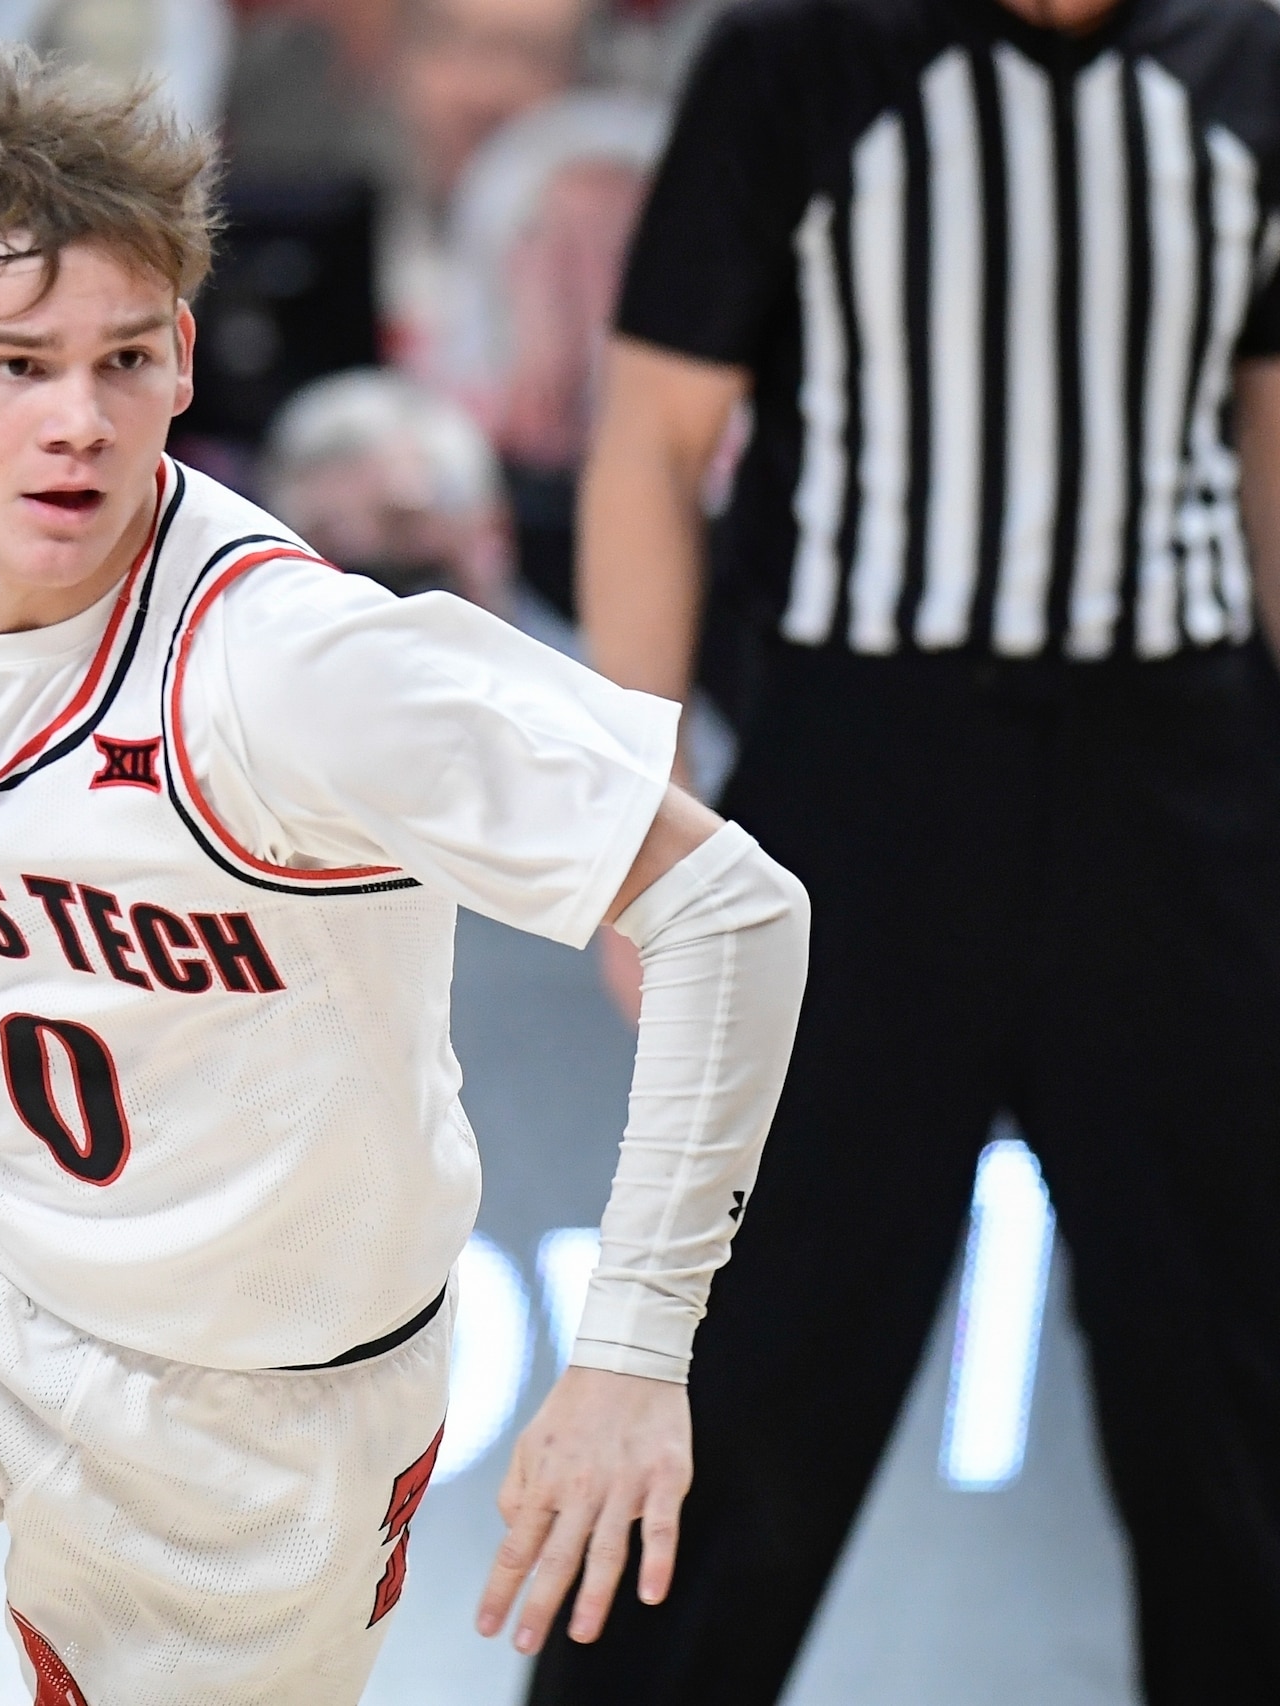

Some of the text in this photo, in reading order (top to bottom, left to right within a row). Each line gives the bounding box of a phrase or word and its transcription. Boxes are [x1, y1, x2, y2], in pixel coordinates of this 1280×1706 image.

[91, 737, 161, 791] XII
[21, 874, 287, 993] TECH
[0, 1012, 131, 1188] 0
